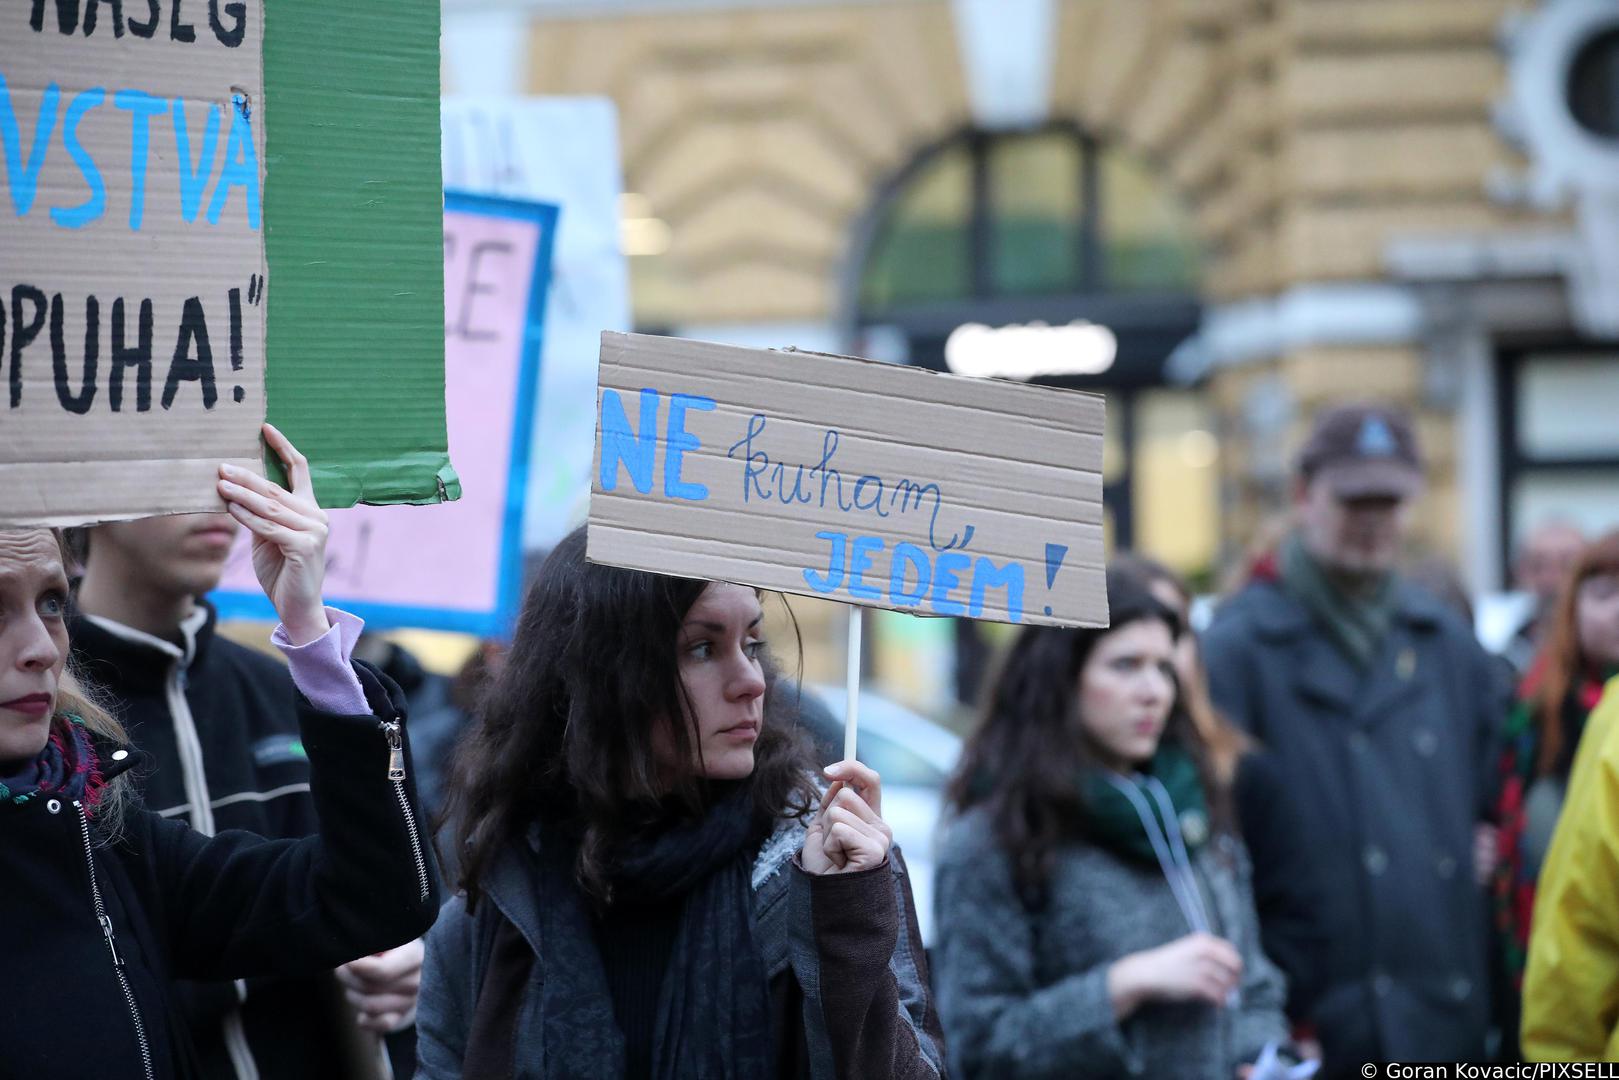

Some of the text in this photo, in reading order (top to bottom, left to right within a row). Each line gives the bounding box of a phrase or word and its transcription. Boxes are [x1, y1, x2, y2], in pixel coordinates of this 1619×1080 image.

[0, 274, 264, 415] PUHA!"
[600, 388, 975, 551] NE kuham,
